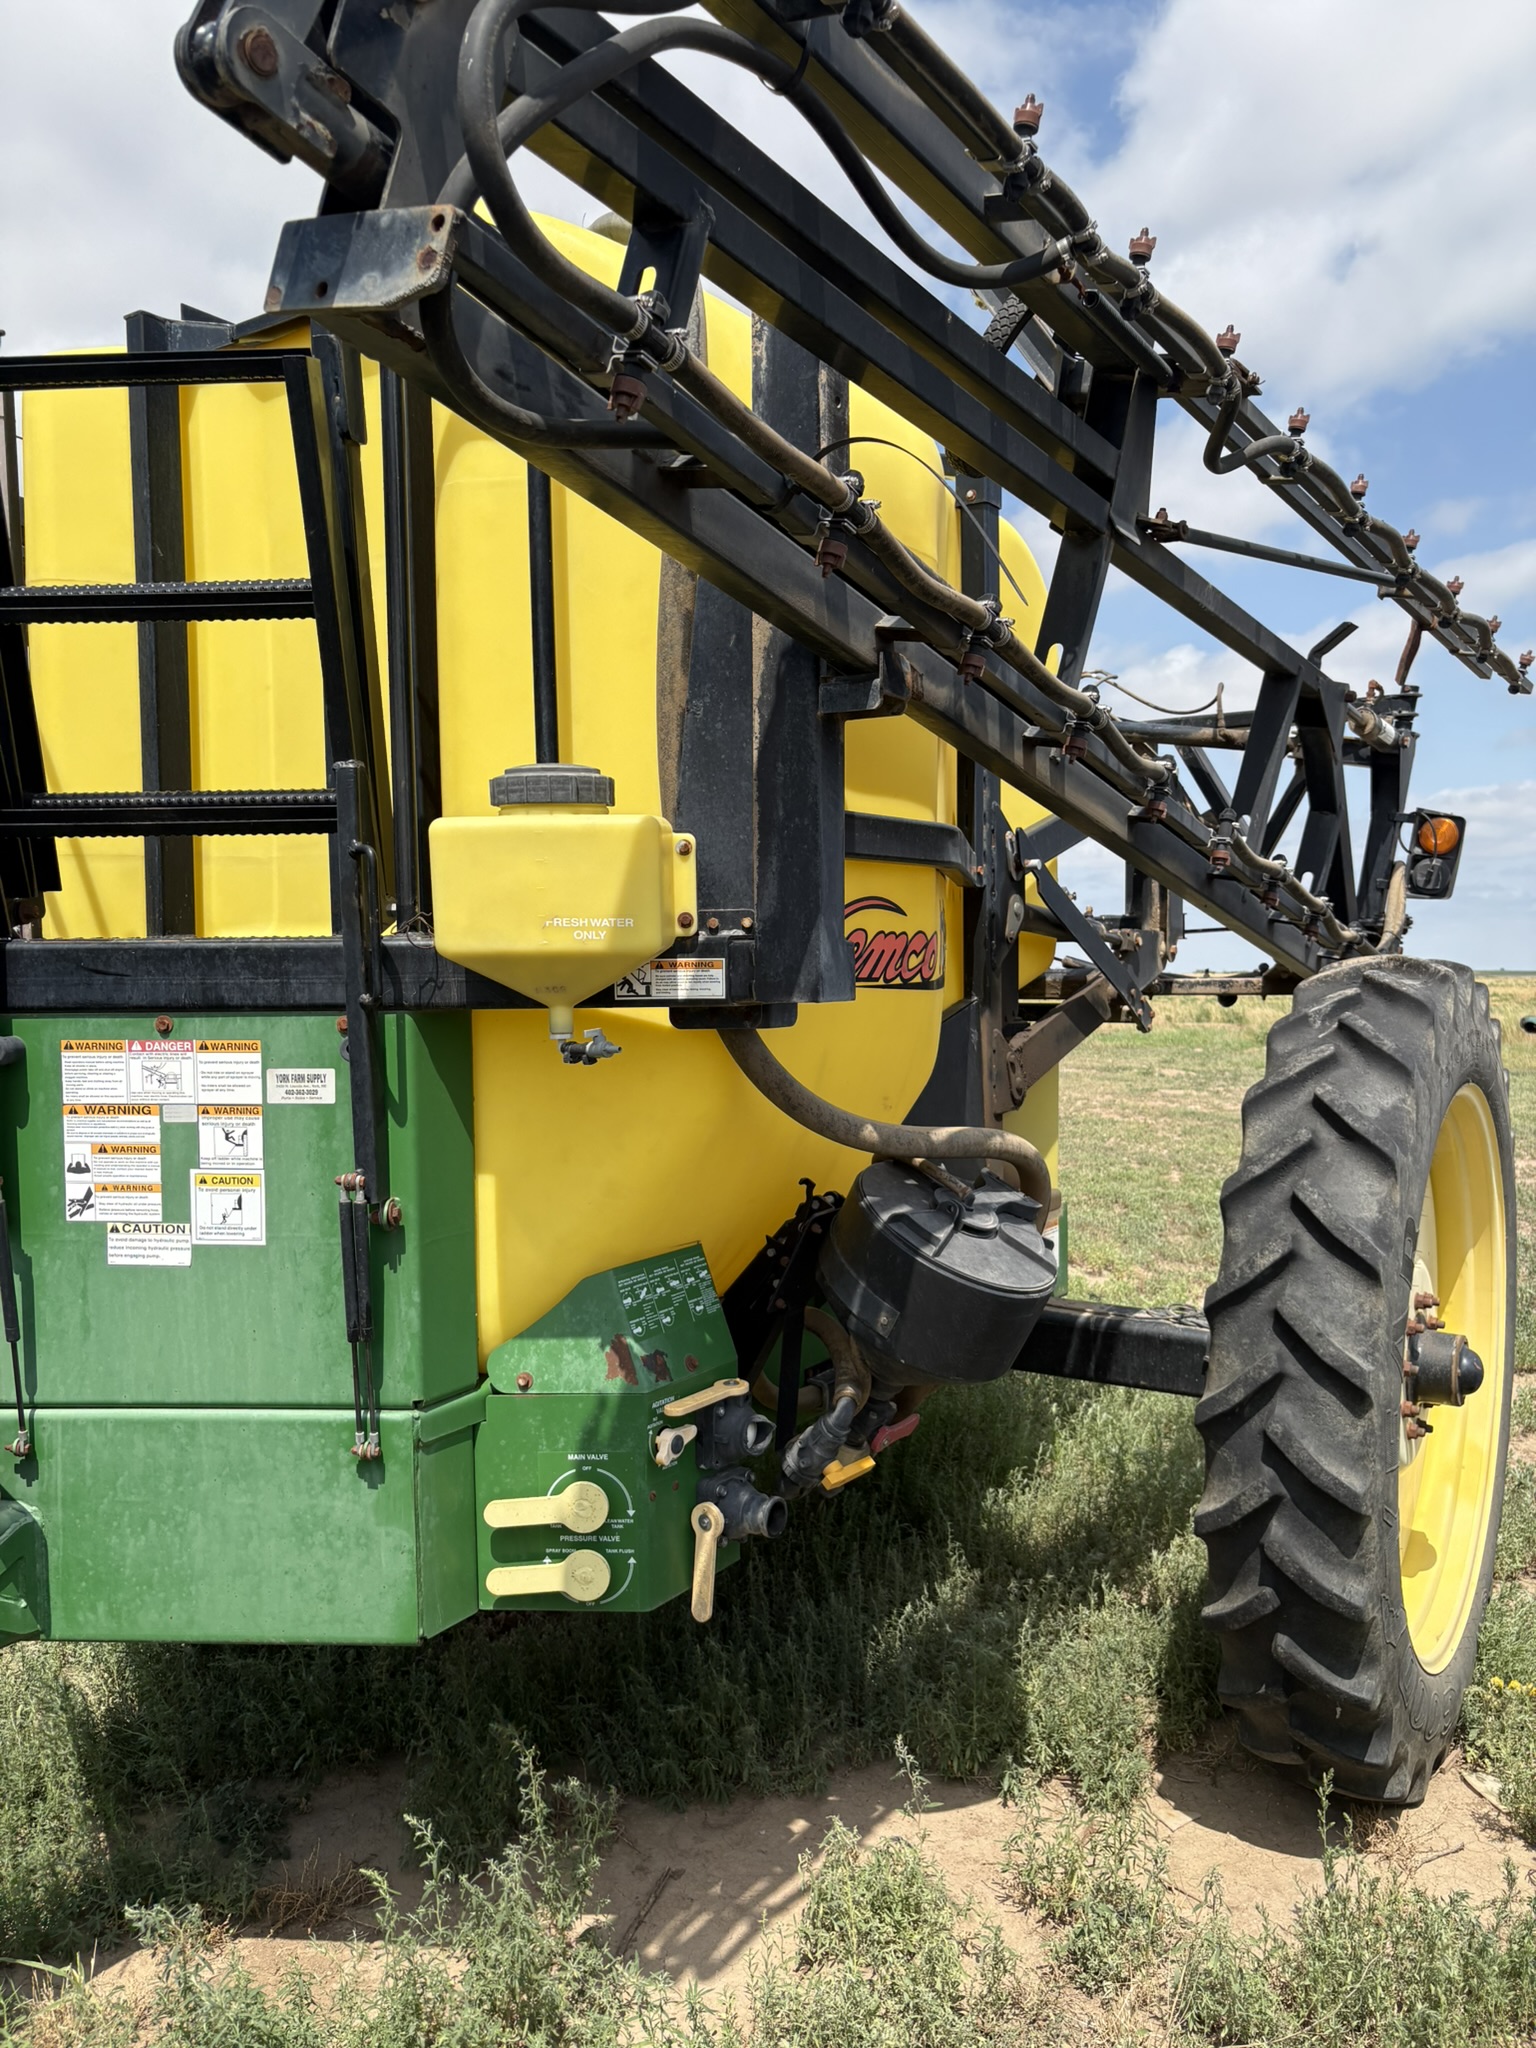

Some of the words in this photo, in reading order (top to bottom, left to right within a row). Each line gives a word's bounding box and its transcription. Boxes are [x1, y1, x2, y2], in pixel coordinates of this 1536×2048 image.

[590, 918, 633, 926] WATER
[574, 930, 606, 940] ONLY
[75, 1042, 123, 1051] WARNING
[145, 1042, 192, 1051] DANGER
[210, 1042, 258, 1051] WARNING
[276, 1074, 290, 1083] YORK
[291, 1074, 305, 1083] FARM
[307, 1074, 326, 1083] SUPPLY
[84, 1106, 151, 1115] WARNING
[122, 1224, 185, 1234] CAUTION
